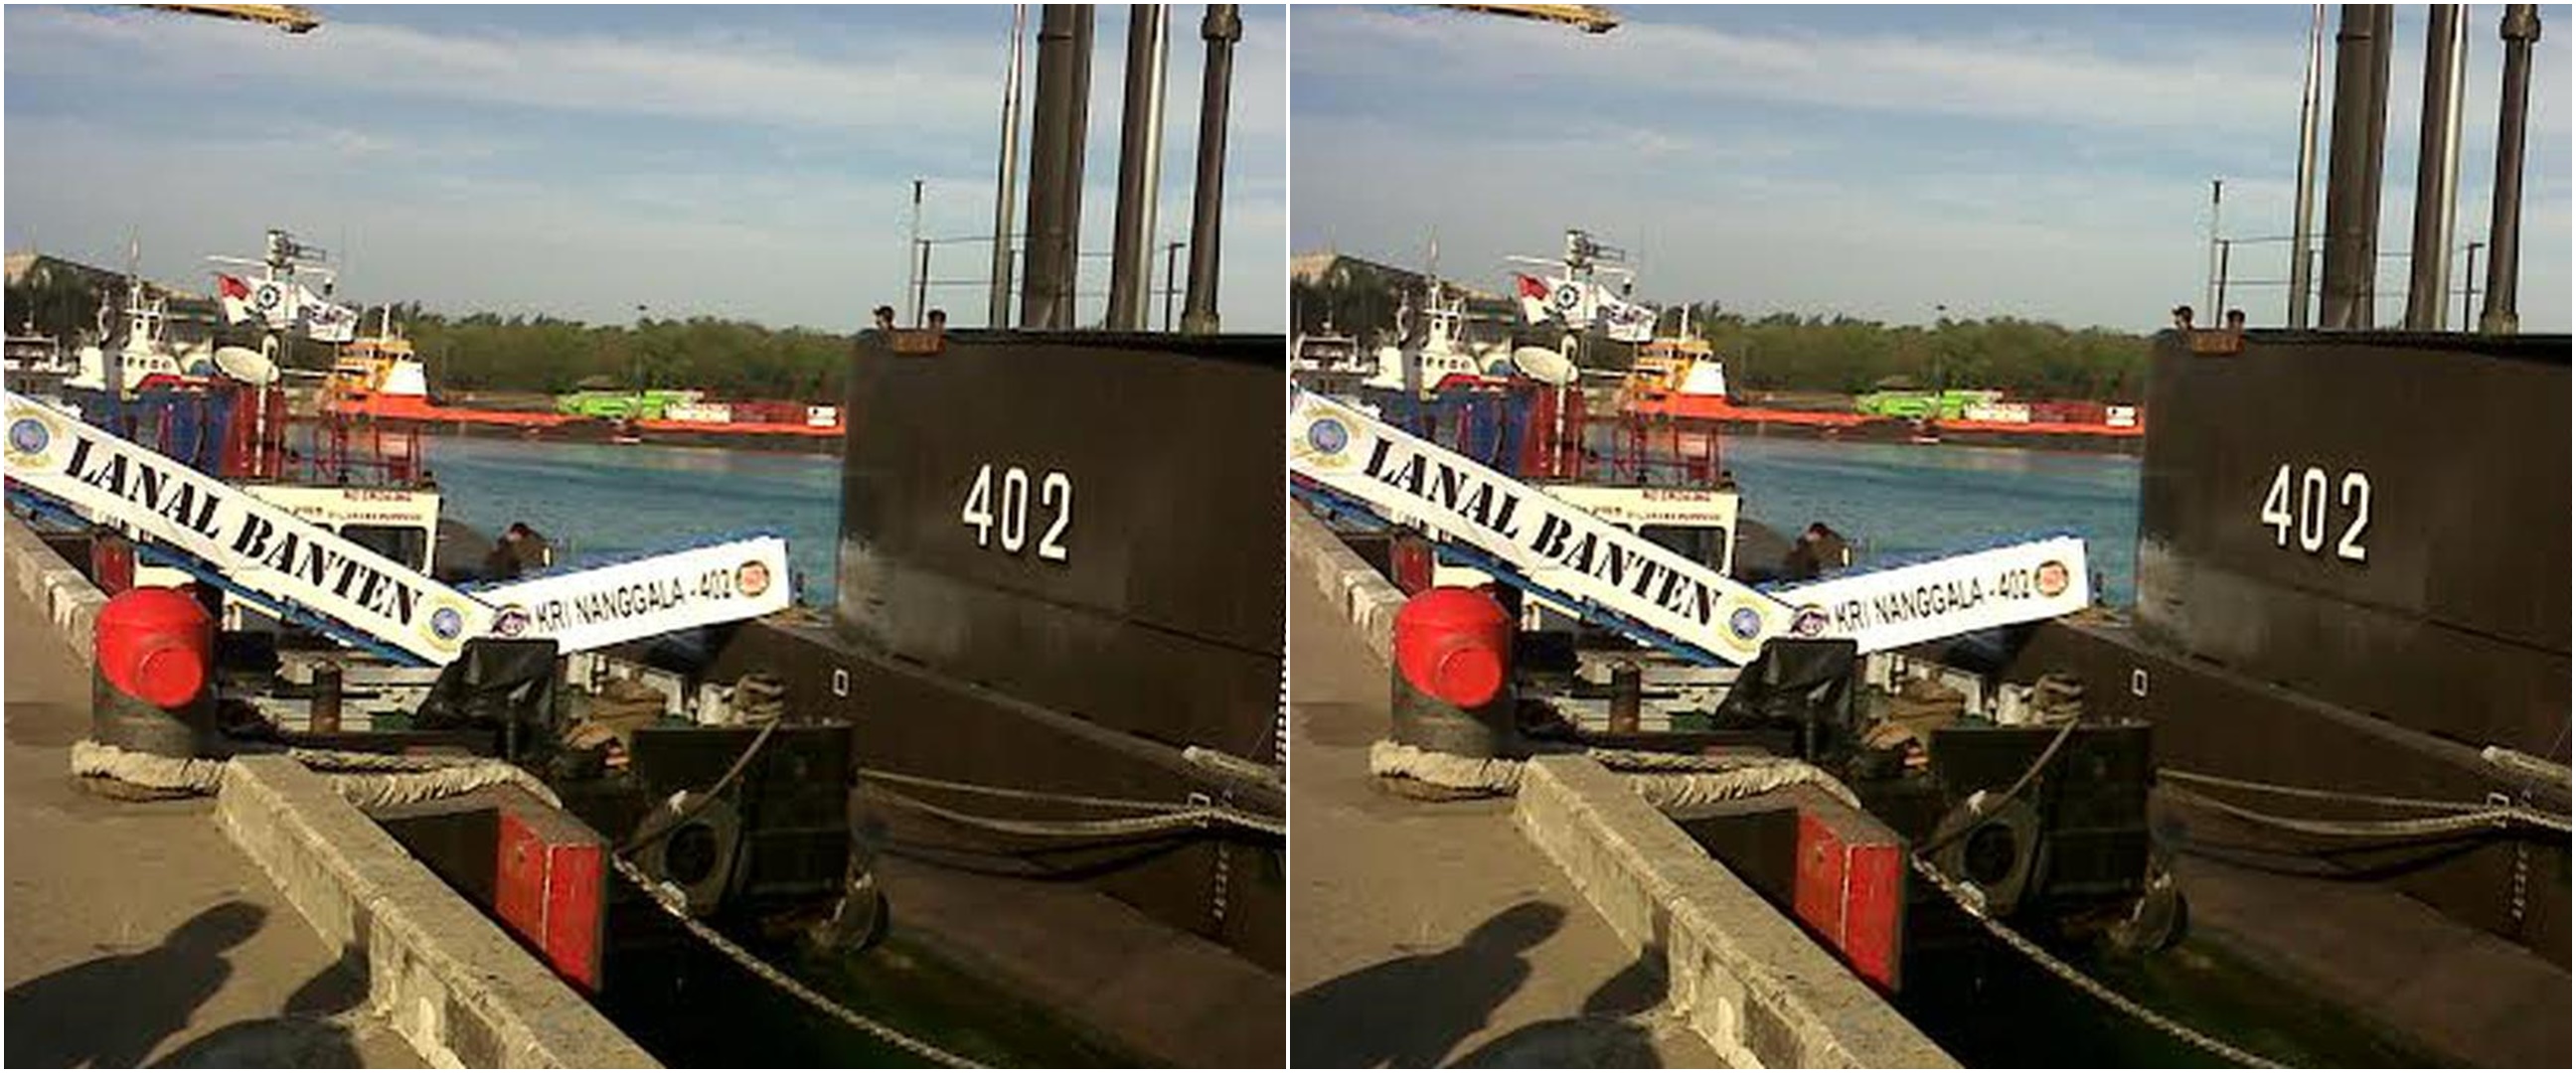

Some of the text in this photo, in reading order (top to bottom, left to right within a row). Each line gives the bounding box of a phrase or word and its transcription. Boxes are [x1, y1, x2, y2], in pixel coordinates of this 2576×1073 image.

[65, 437, 423, 625] LANAL BANTEN
[963, 464, 1070, 560] 402
[1364, 437, 1722, 625] LANAL BANTEN
[2262, 464, 2369, 560] 402
[536, 600, 572, 633] KRI
[575, 577, 685, 624] NANGGALA
[1835, 600, 1871, 633] KRI
[1874, 577, 1984, 624] NANGGALA
